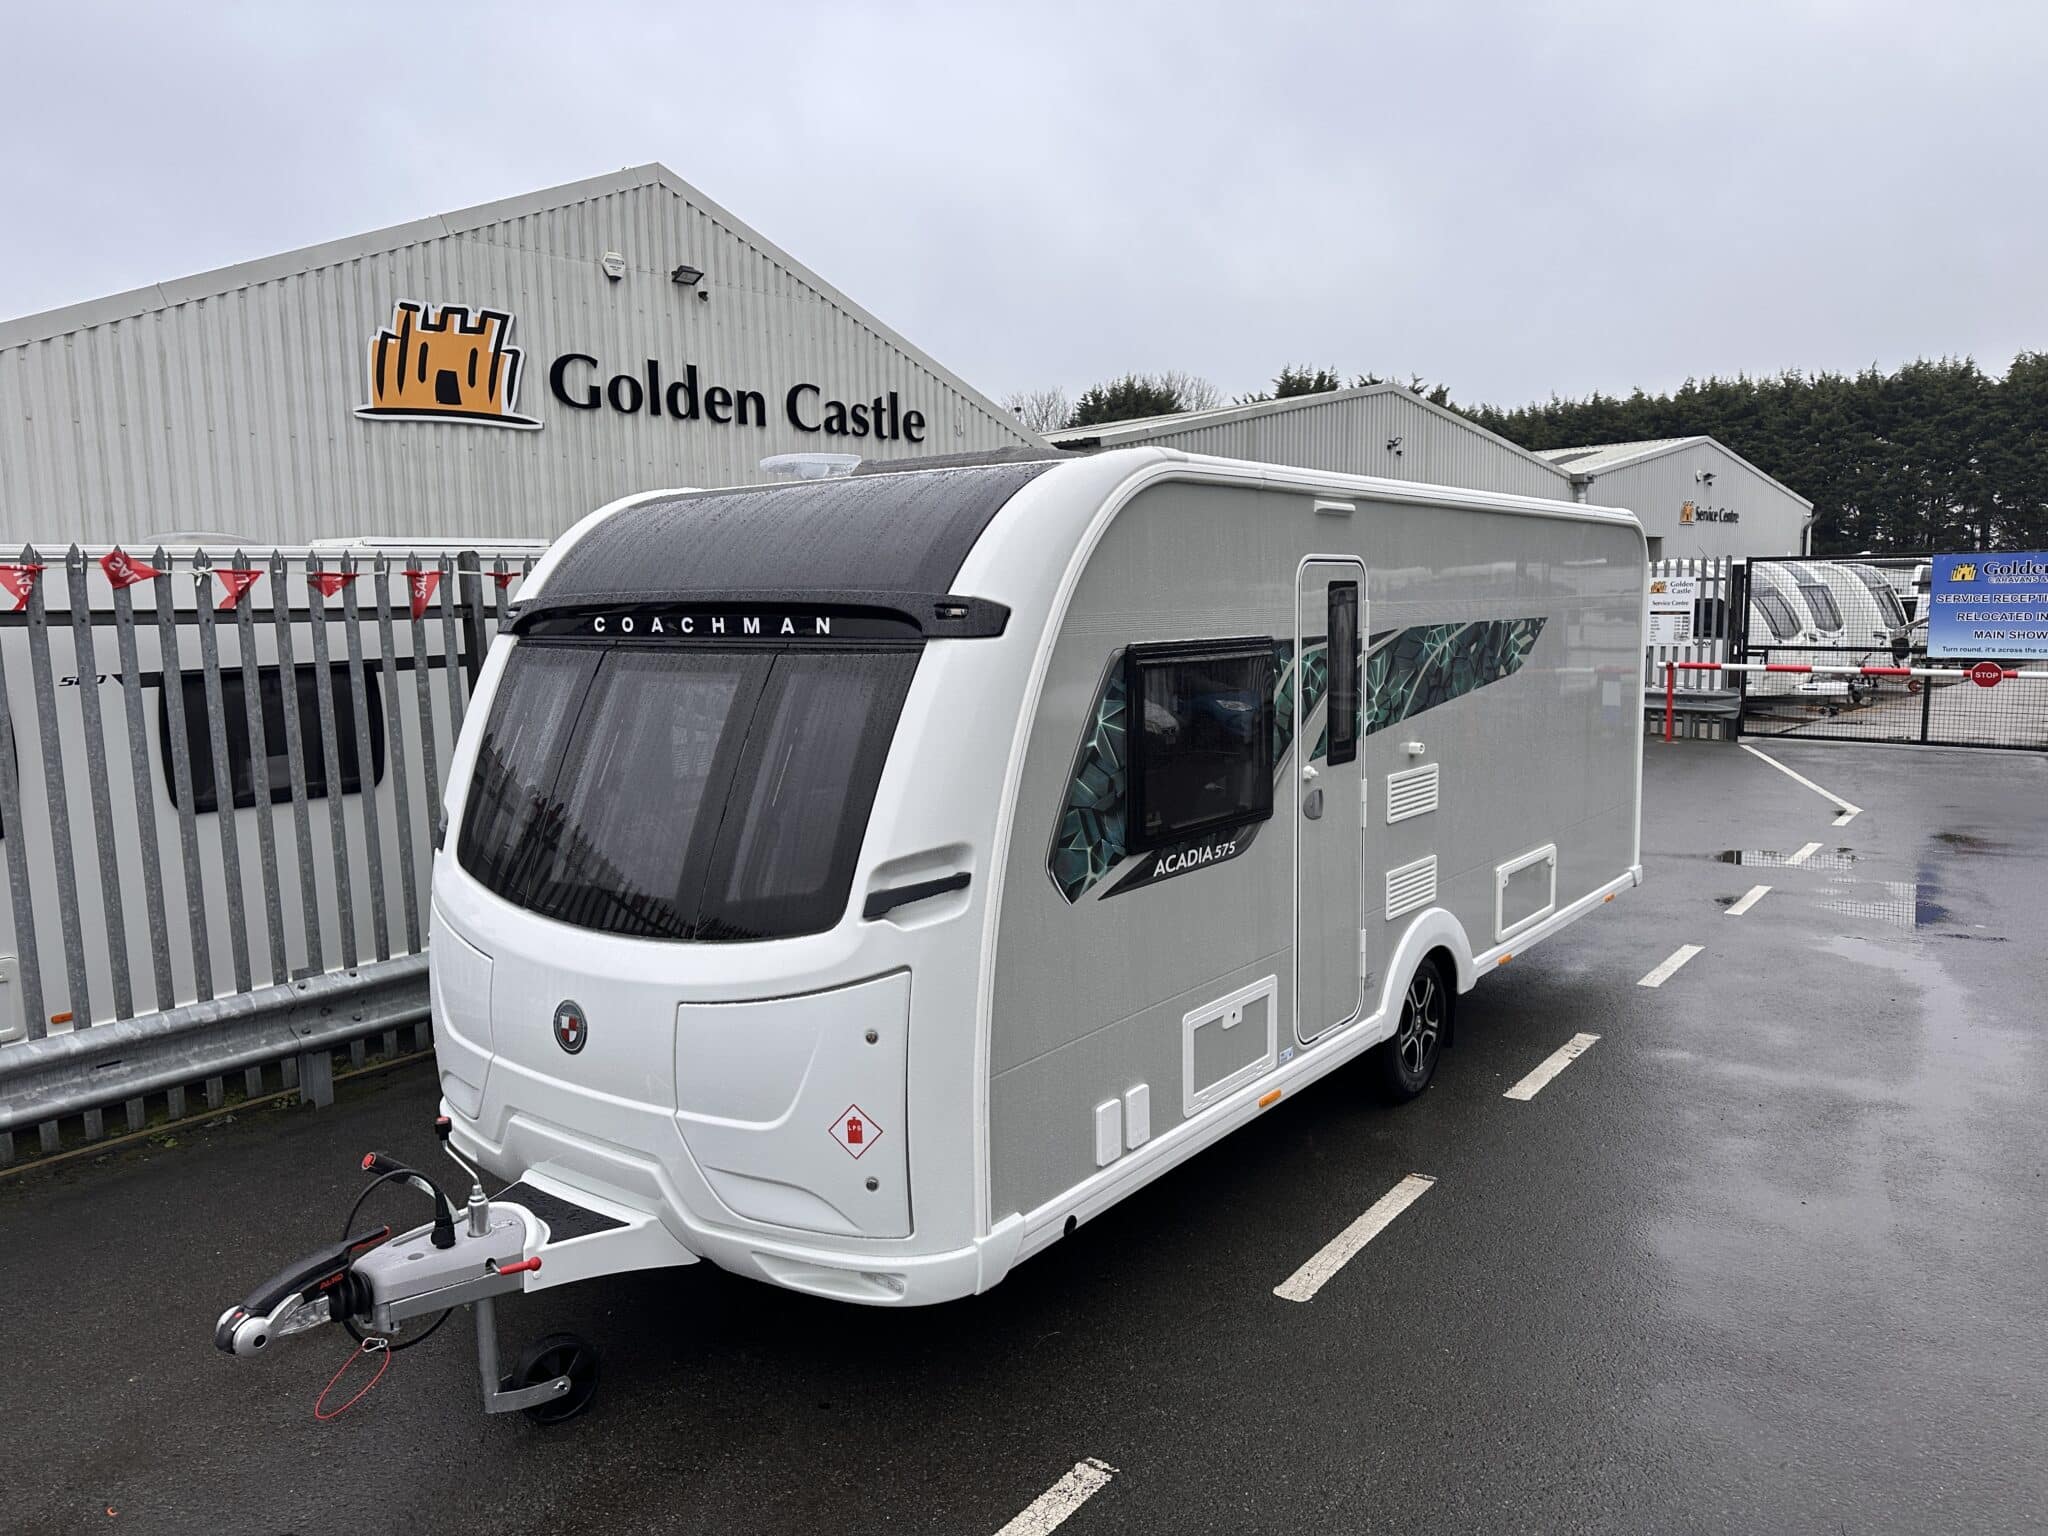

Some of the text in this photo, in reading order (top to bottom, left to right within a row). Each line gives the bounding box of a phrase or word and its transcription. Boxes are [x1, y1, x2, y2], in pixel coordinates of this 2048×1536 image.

[549, 353, 926, 442] Golden Castle
[1696, 506, 1739, 523] Service Centre
[1936, 594, 1990, 603] SERVICE
[1957, 612, 2032, 621] RELOCATED
[594, 617, 830, 634] COACHMAN
[1974, 630, 2048, 639] MAIN SHOW
[1975, 671, 1998, 679] STOP
[1153, 841, 1236, 877] ACADIA 575
